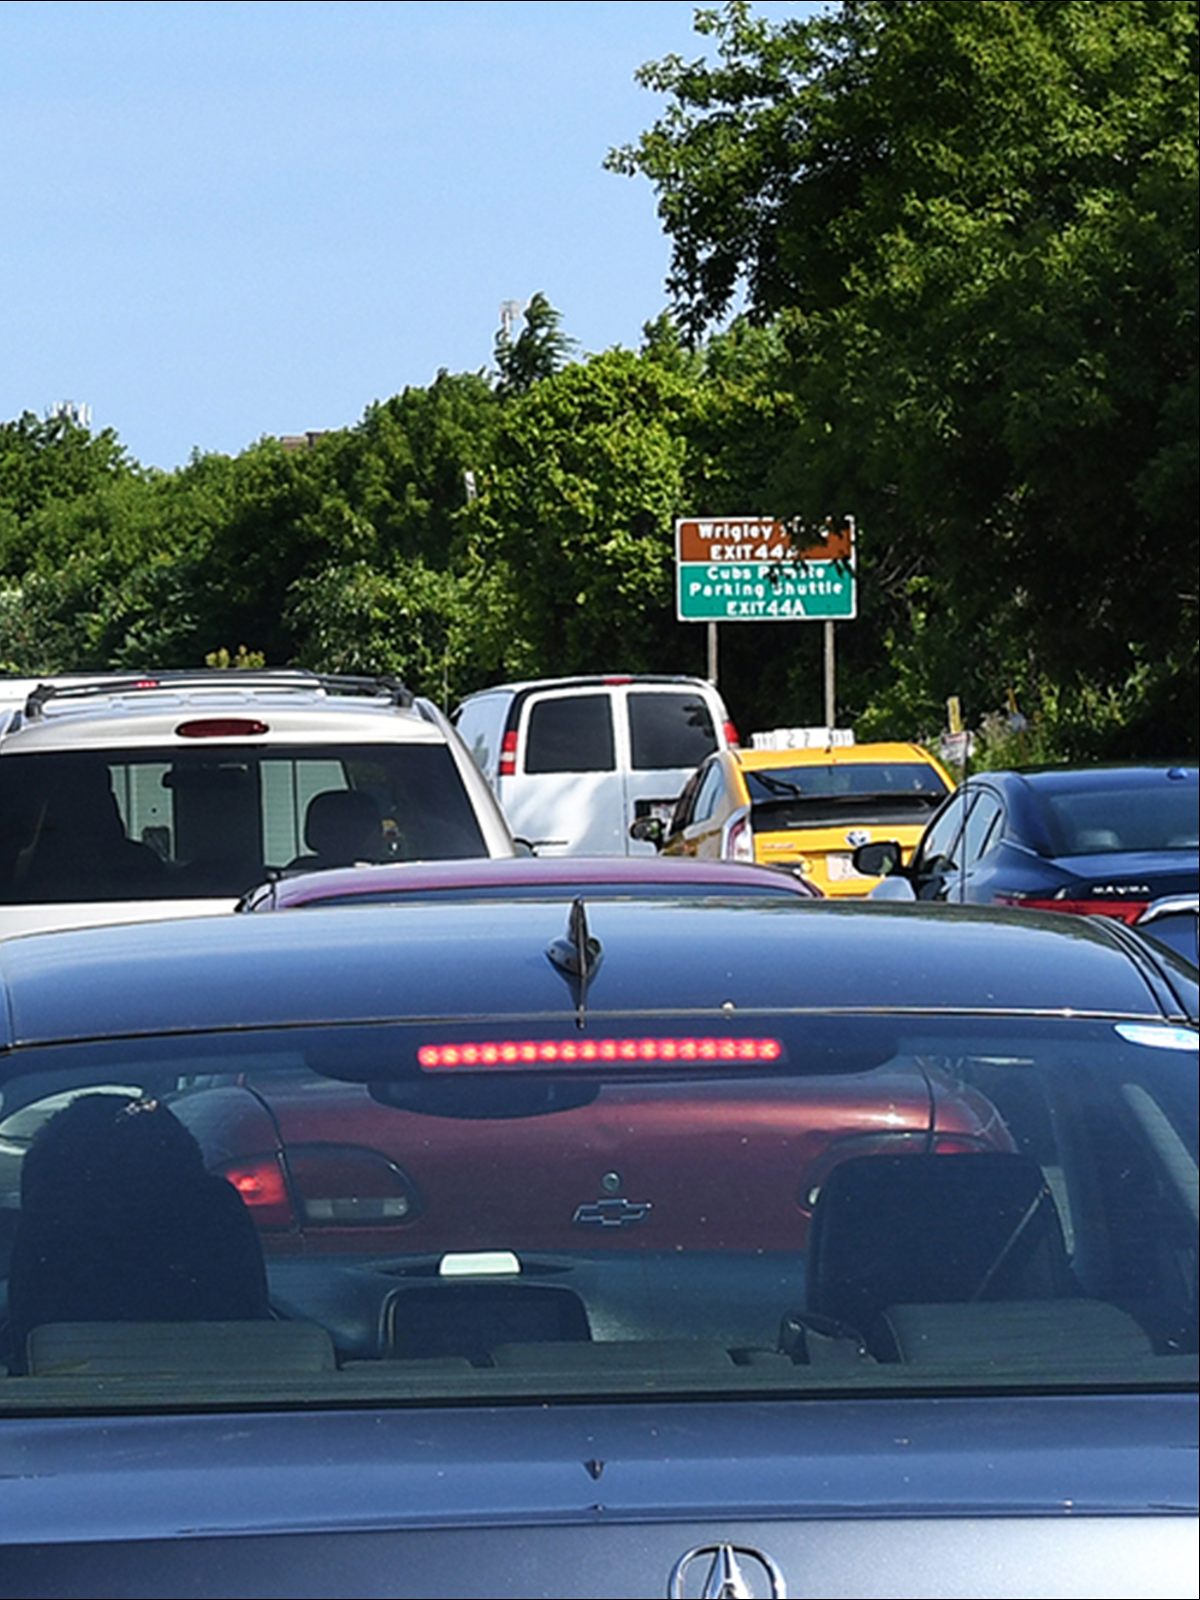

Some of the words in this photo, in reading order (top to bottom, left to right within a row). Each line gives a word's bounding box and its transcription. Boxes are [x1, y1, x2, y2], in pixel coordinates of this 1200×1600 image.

[698, 523, 773, 542] Wrigley
[707, 566, 752, 580] Cubs
[689, 581, 765, 599] Parking
